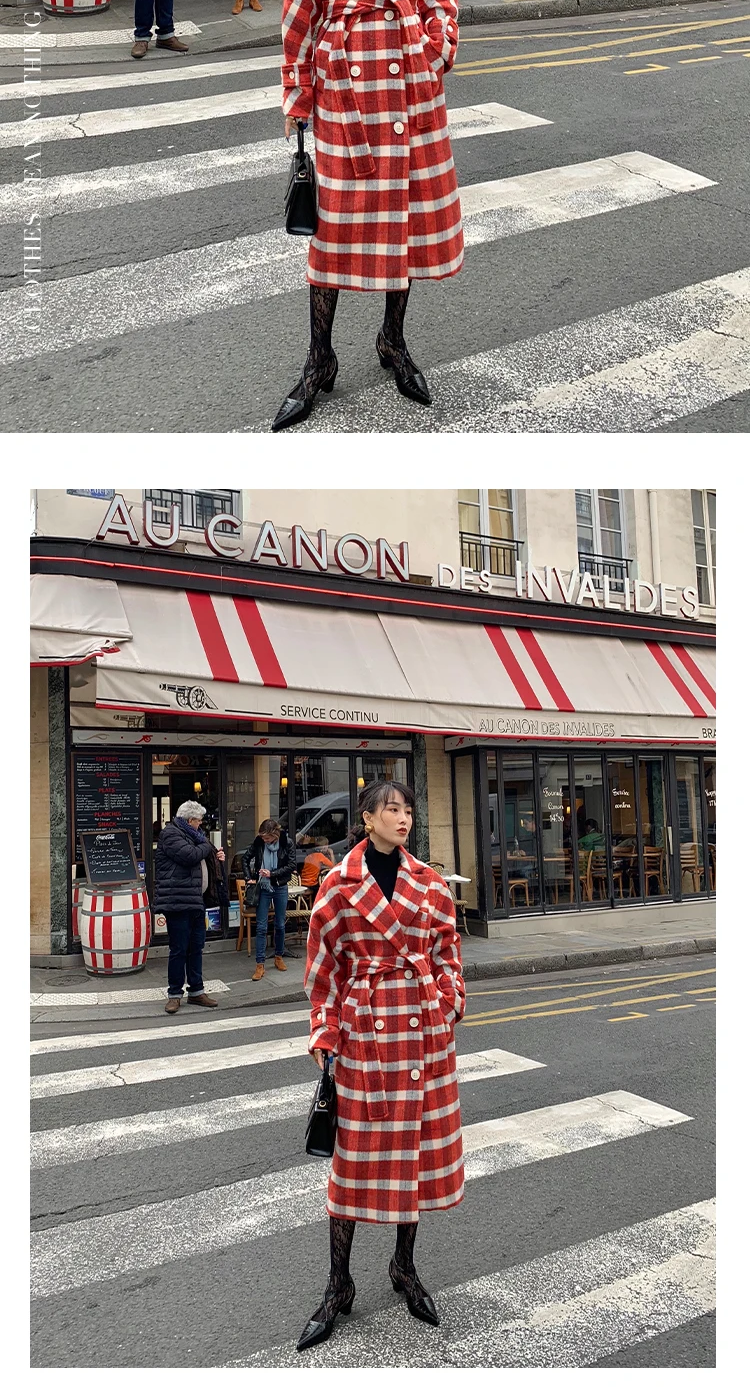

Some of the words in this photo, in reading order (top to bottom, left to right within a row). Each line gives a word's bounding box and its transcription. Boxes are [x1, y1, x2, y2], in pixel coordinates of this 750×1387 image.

[96, 493, 181, 548] AU
[204, 513, 410, 582] CANON
[438, 563, 493, 593] DES
[515, 560, 700, 620] INVALIDES
[280, 704, 327, 720] SERVICE
[329, 708, 379, 724] CONTINU
[479, 718, 494, 733] AU
[496, 717, 539, 735] CANON
[541, 721, 561, 736] DES
[563, 721, 615, 737] INVALIDES
